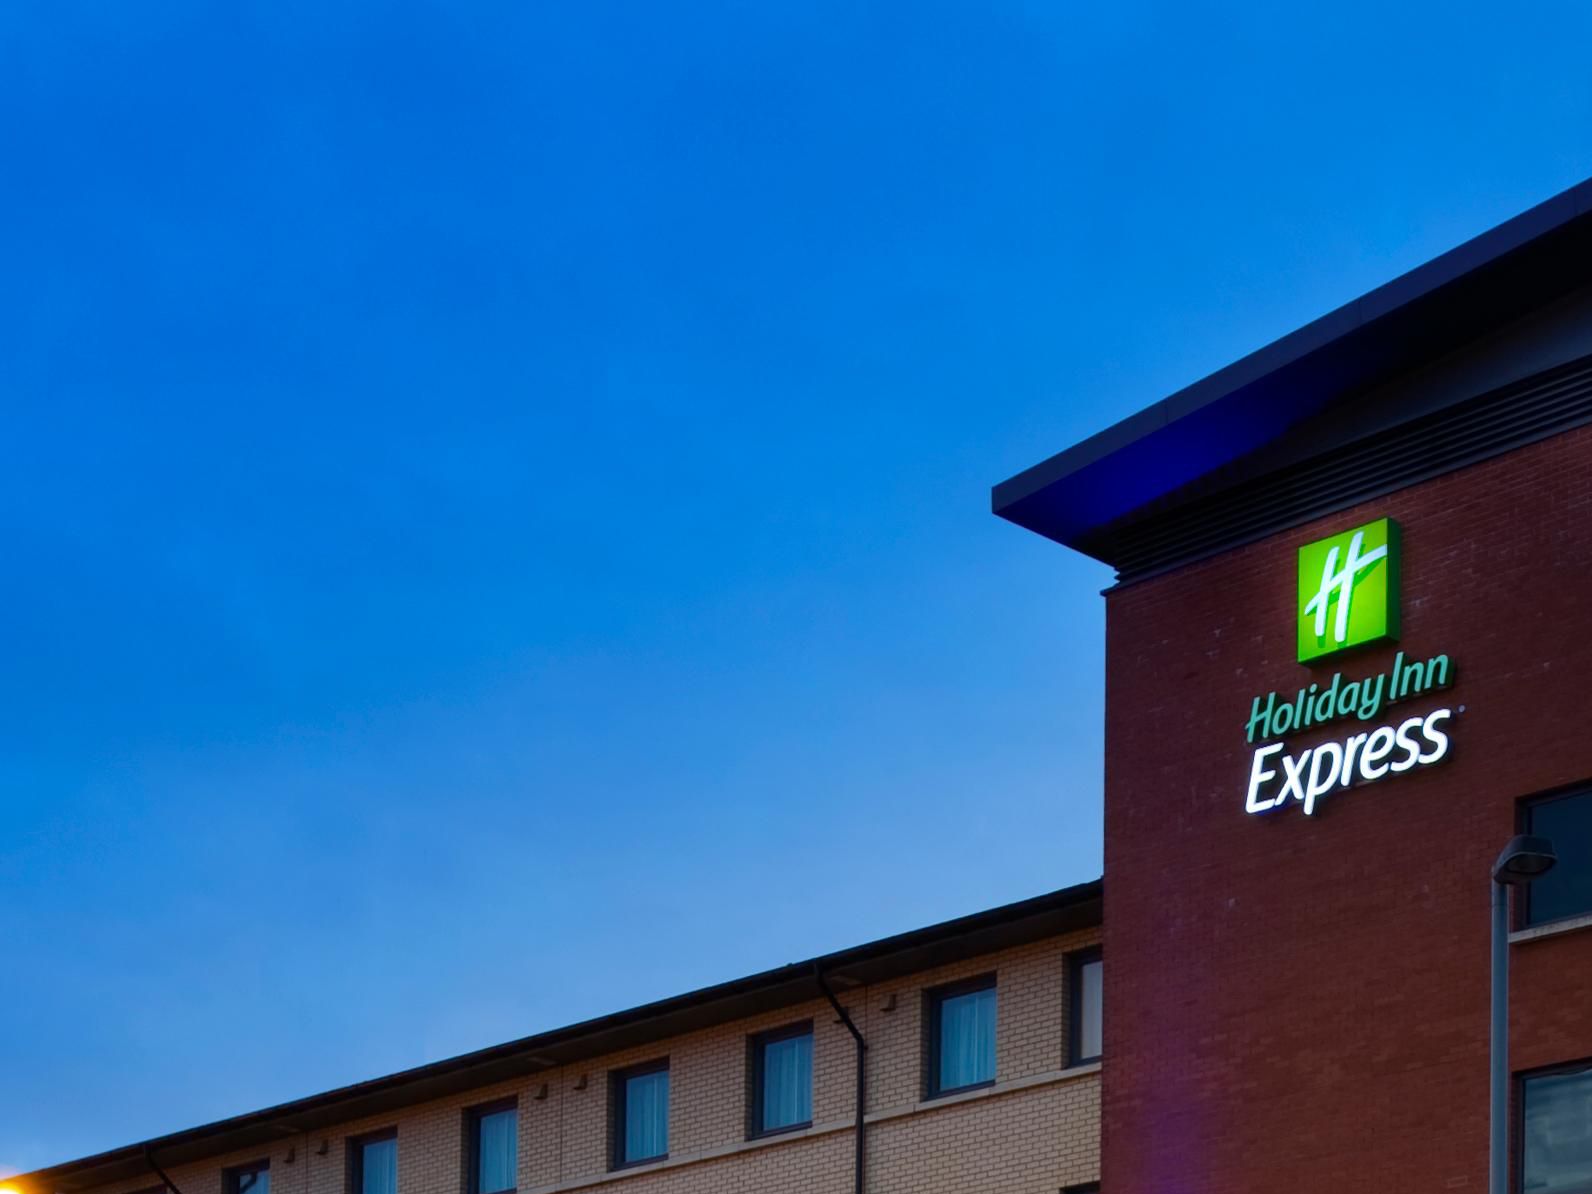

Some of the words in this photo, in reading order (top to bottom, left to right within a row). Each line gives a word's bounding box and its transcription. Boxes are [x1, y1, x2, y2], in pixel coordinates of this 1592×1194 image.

[1245, 672, 1385, 743] Holiday
[1389, 651, 1449, 700] Inn
[1246, 708, 1451, 815] Express
